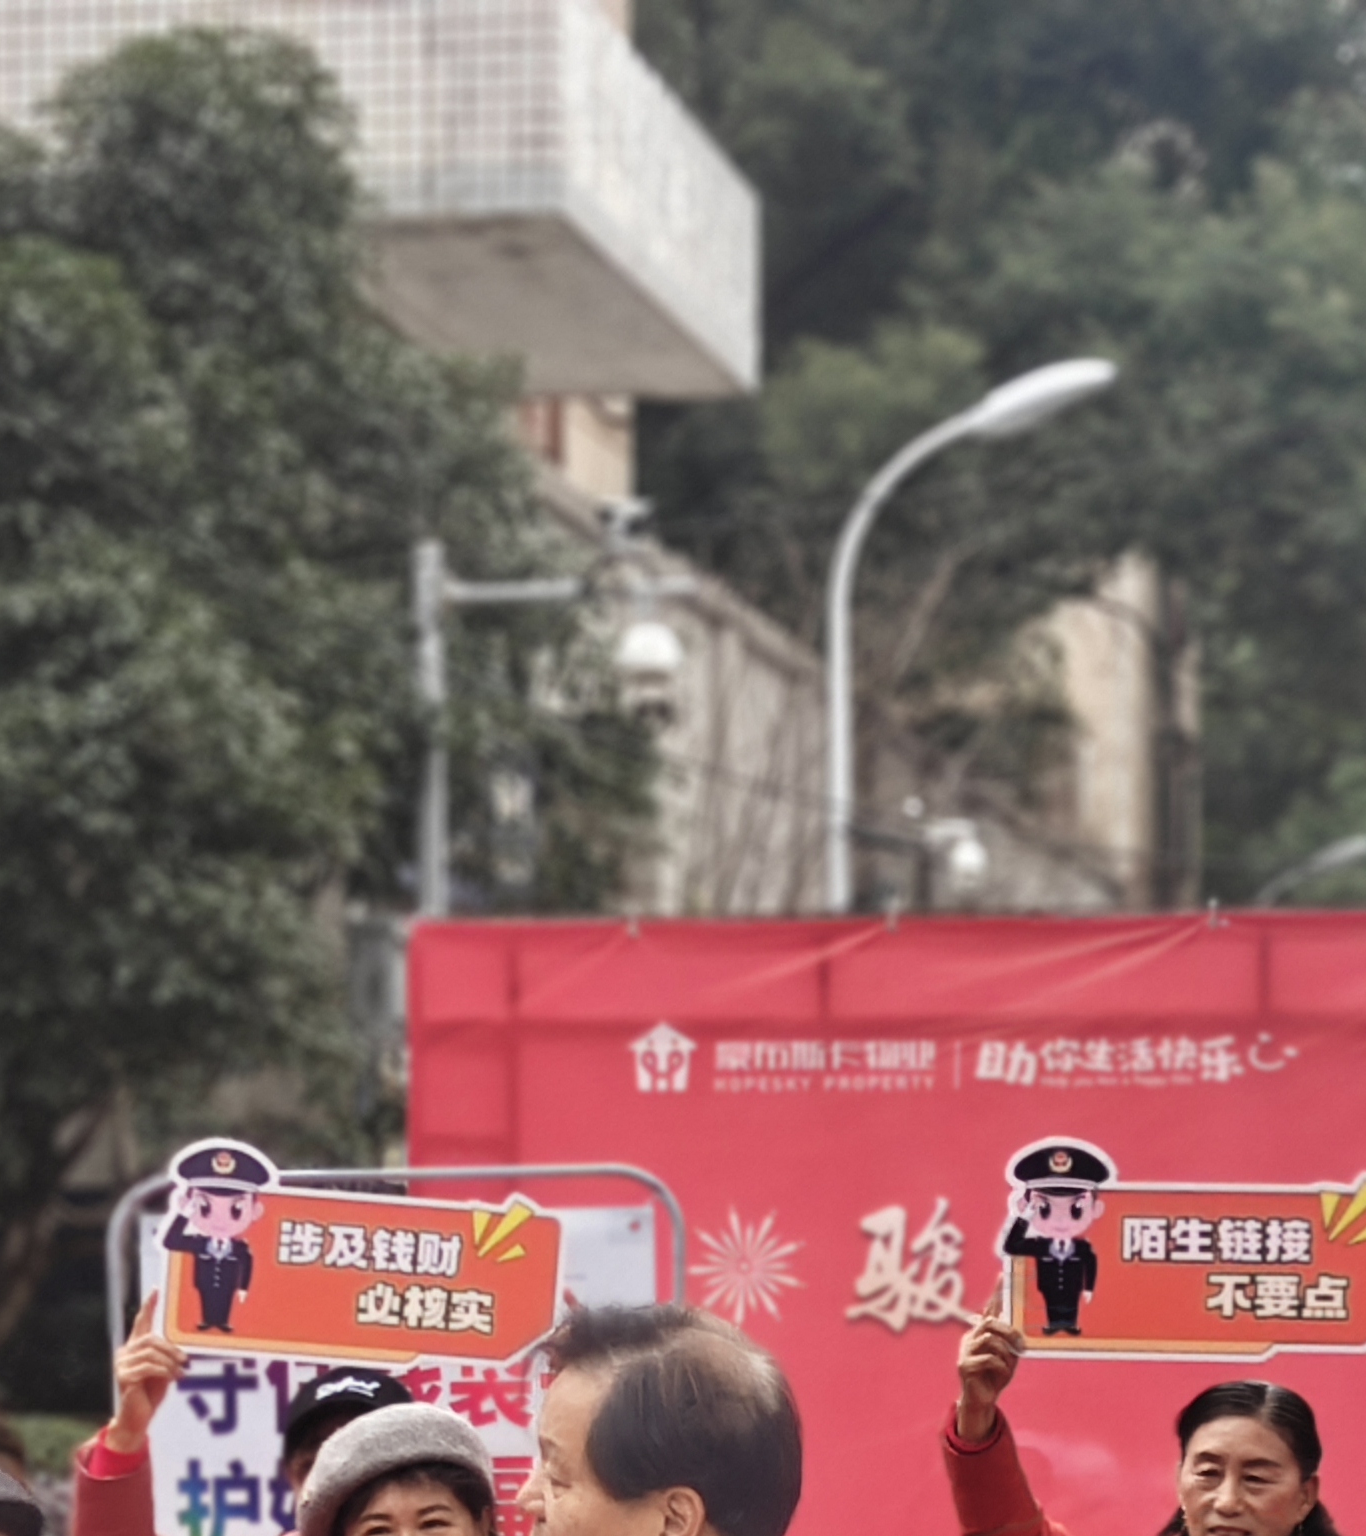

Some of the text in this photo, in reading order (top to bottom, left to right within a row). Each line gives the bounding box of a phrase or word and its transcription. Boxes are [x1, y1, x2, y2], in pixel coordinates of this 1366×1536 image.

[975, 1034, 1245, 1085] 助你生活快乐
[823, 1076, 936, 1093] PROPERTY
[277, 1219, 464, 1278] 涉及钱财
[1121, 1216, 1313, 1264] 陌生链接
[356, 1283, 494, 1335] 必核实
[1206, 1273, 1349, 1320] 不要点
